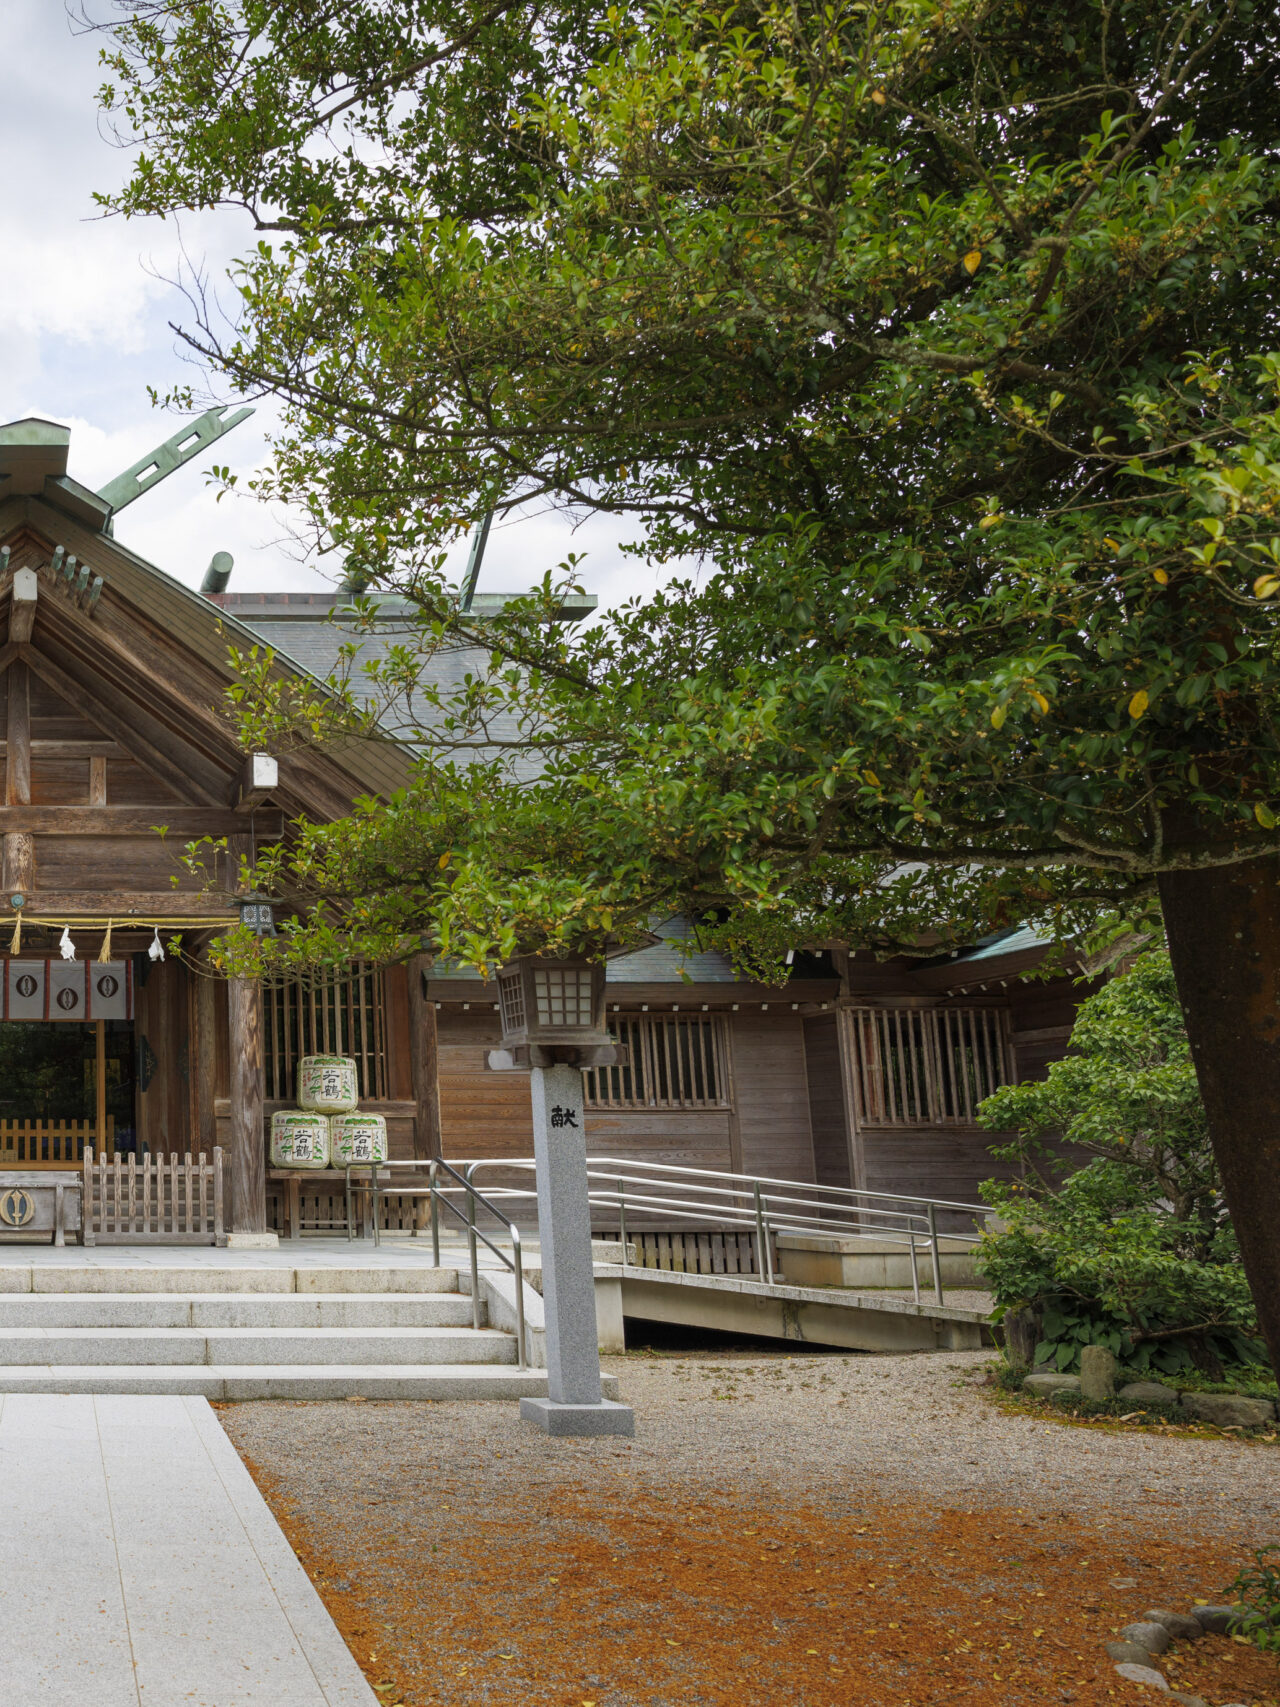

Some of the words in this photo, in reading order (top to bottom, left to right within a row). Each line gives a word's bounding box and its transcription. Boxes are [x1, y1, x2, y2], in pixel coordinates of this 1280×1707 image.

[321, 1070, 341, 1099] 若鶴
[551, 1105, 579, 1128] 献
[292, 1129, 313, 1159] 若鶴
[352, 1130, 373, 1160] 若鶴
